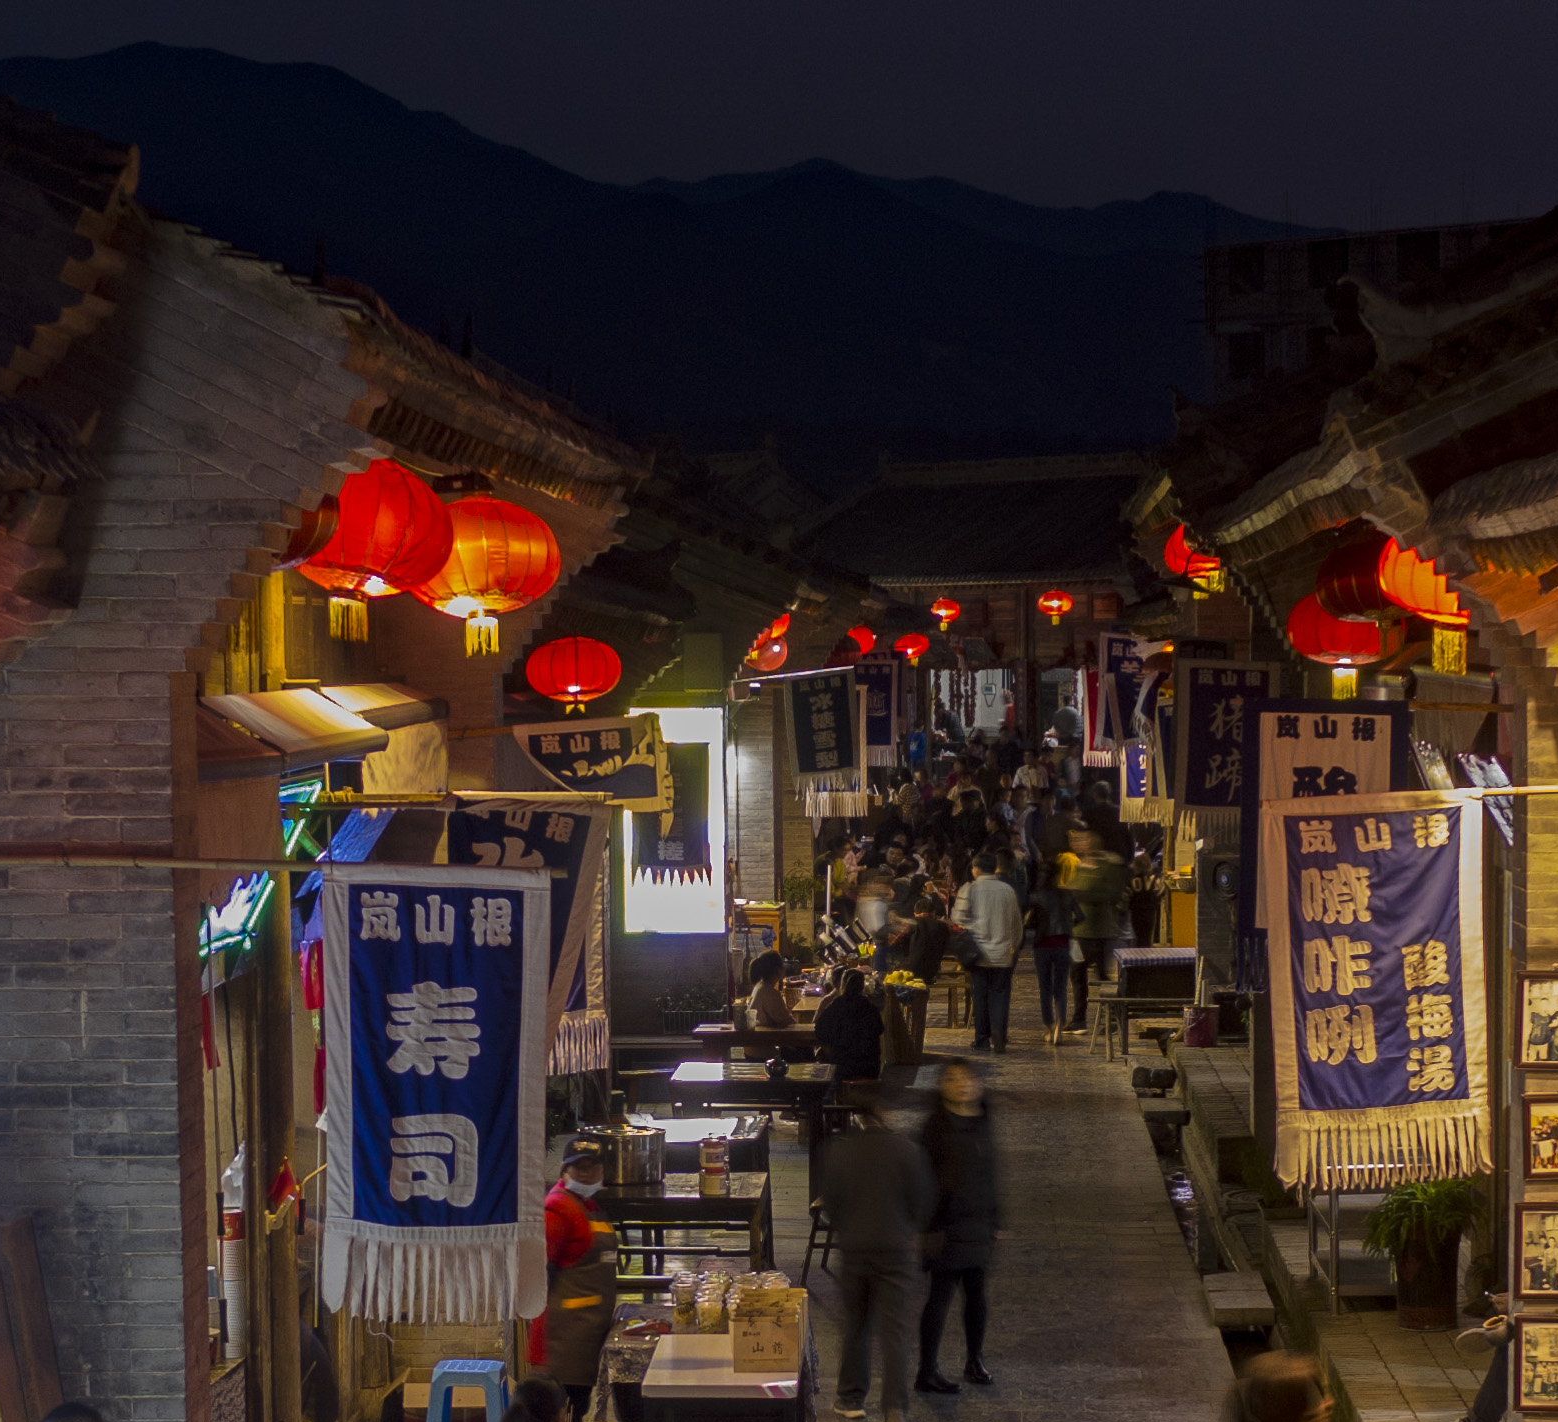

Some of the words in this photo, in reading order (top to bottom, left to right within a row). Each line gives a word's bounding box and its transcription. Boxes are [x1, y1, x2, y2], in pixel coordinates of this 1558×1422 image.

[540, 730, 622, 755] 岚山根
[1277, 715, 1376, 742] 岚山根
[1299, 813, 1450, 855] 岚山根
[359, 890, 514, 949] 岚山根
[386, 980, 481, 1208] 寿司
